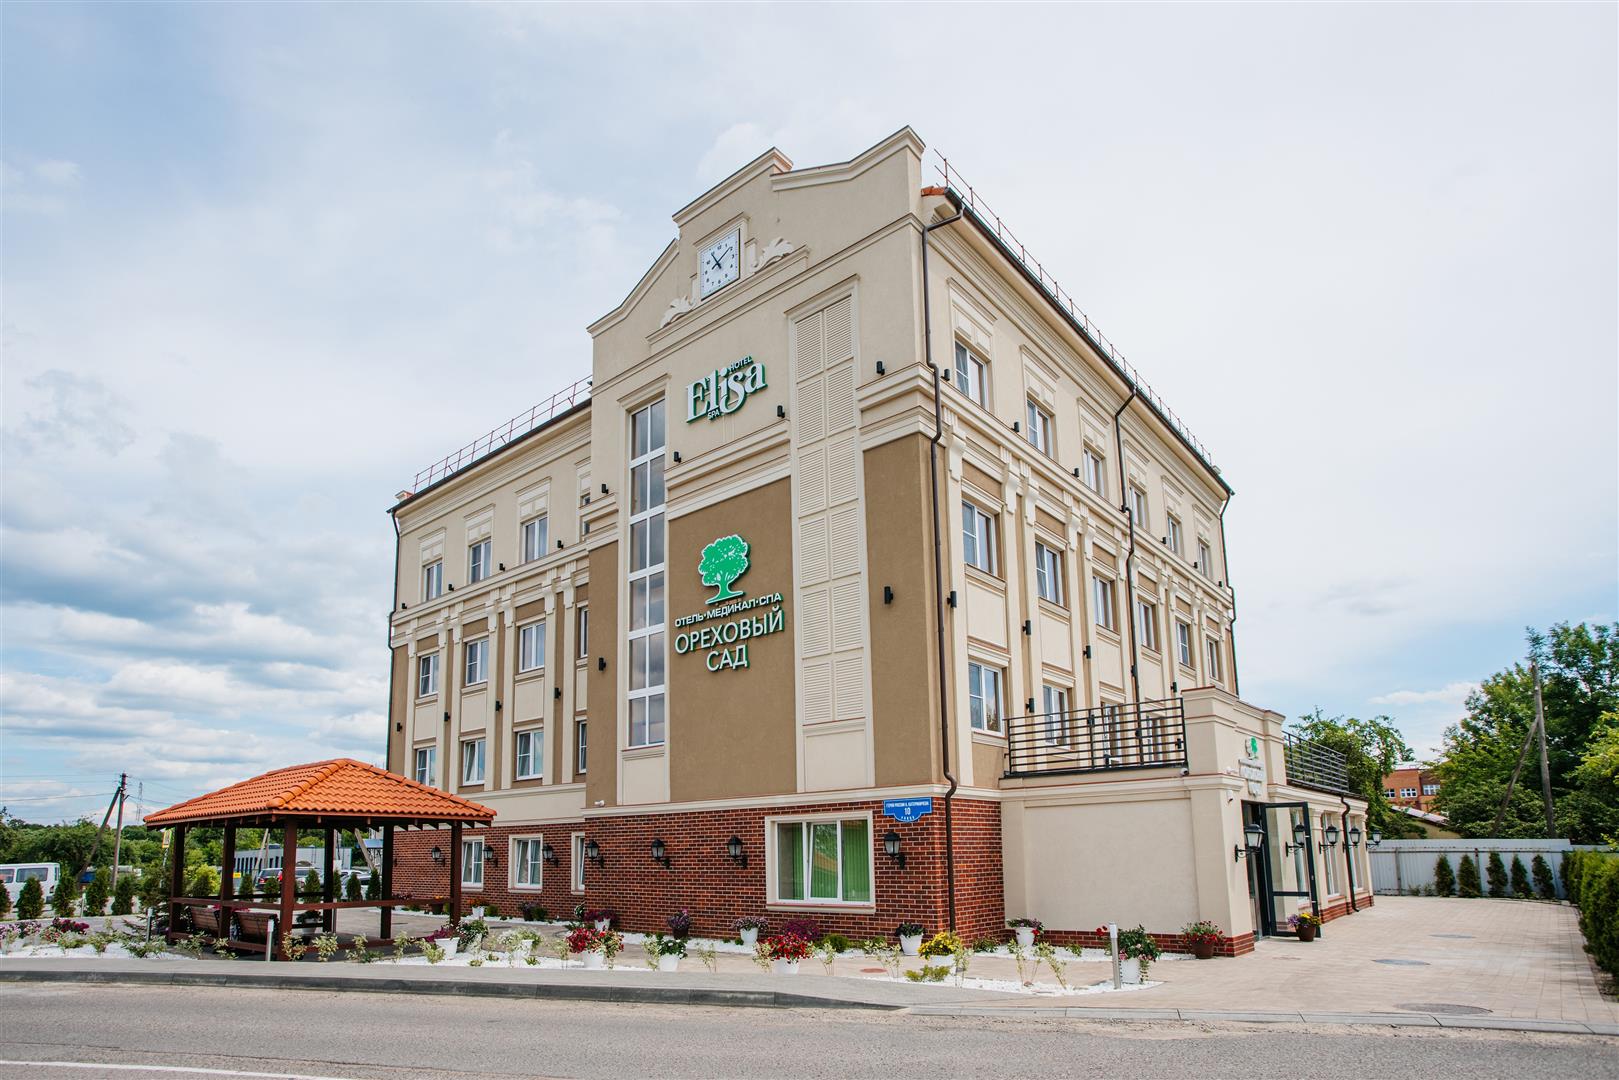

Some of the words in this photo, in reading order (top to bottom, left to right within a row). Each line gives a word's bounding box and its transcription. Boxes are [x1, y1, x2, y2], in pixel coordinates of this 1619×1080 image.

[730, 356, 753, 372] HOTEL
[686, 362, 768, 423] Elisa
[707, 408, 720, 420] SPA
[675, 604, 784, 654] ОРЕХОВЫЙ
[706, 644, 750, 671] САД
